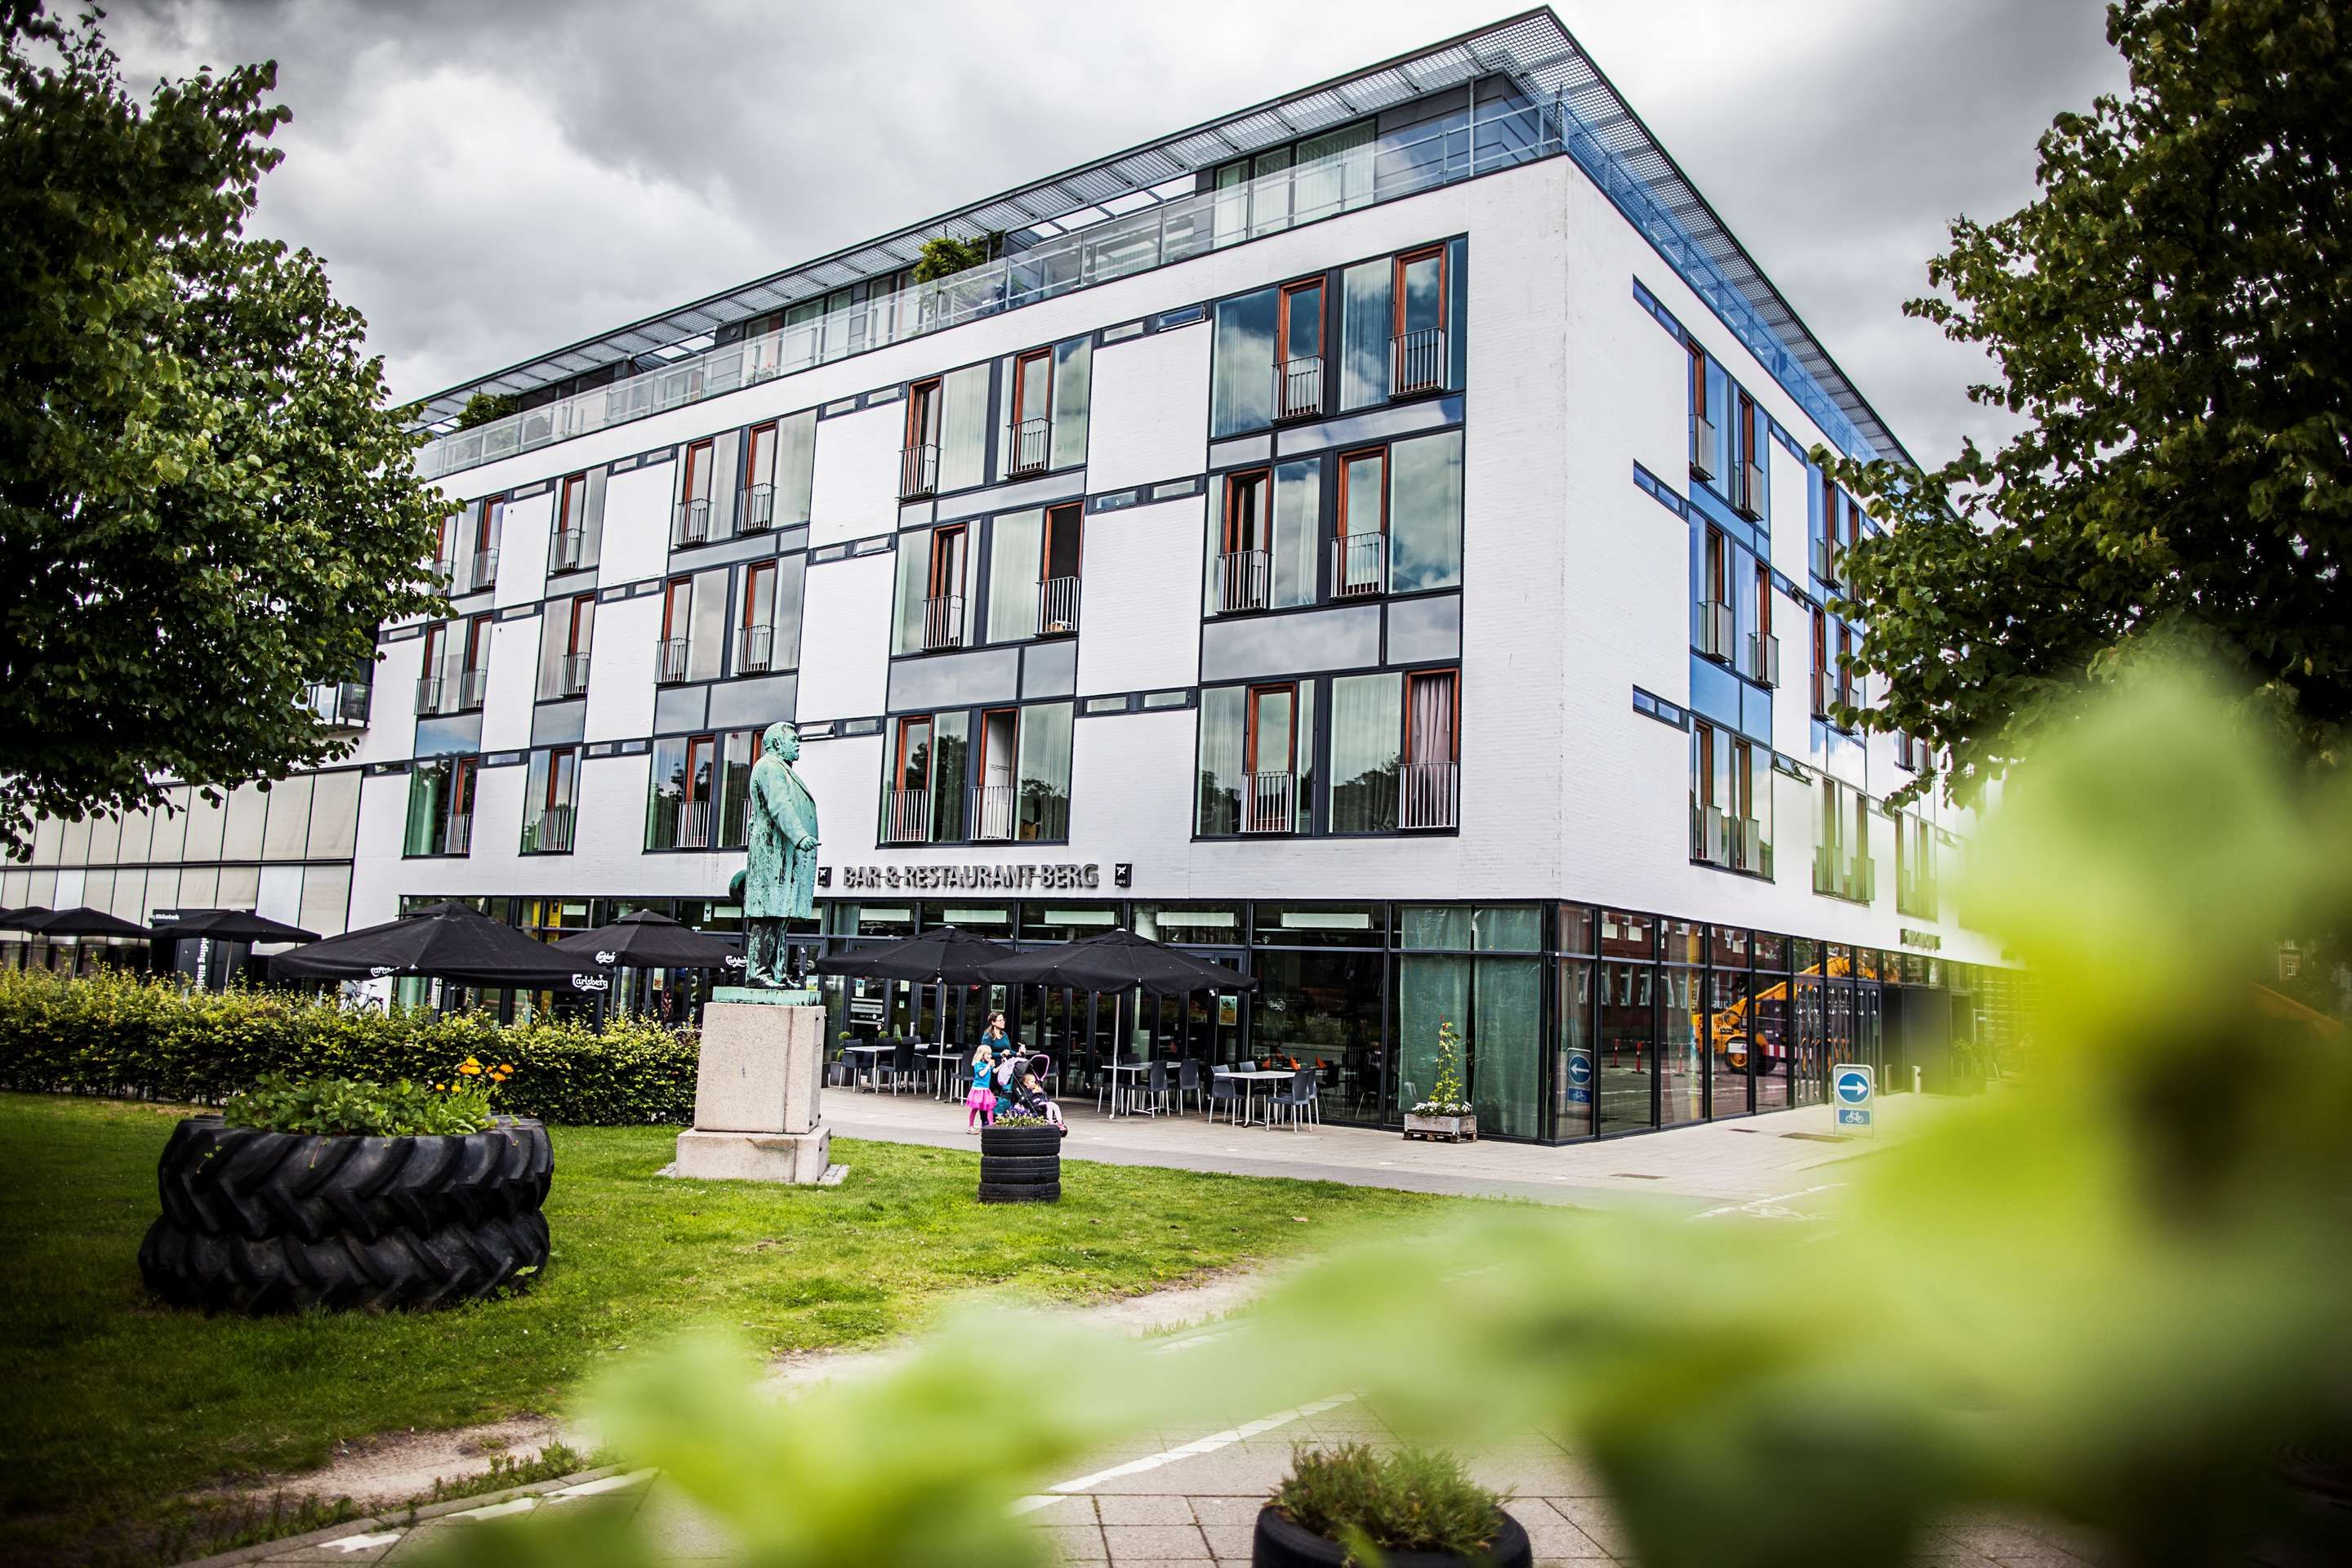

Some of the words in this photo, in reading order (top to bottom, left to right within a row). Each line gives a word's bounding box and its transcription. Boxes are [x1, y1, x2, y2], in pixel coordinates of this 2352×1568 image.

[843, 866, 881, 888] BAR
[885, 866, 900, 888] &
[903, 865, 1037, 889] RESTAURANT
[1040, 863, 1099, 889] BERG
[572, 973, 608, 992] Carlsberg
